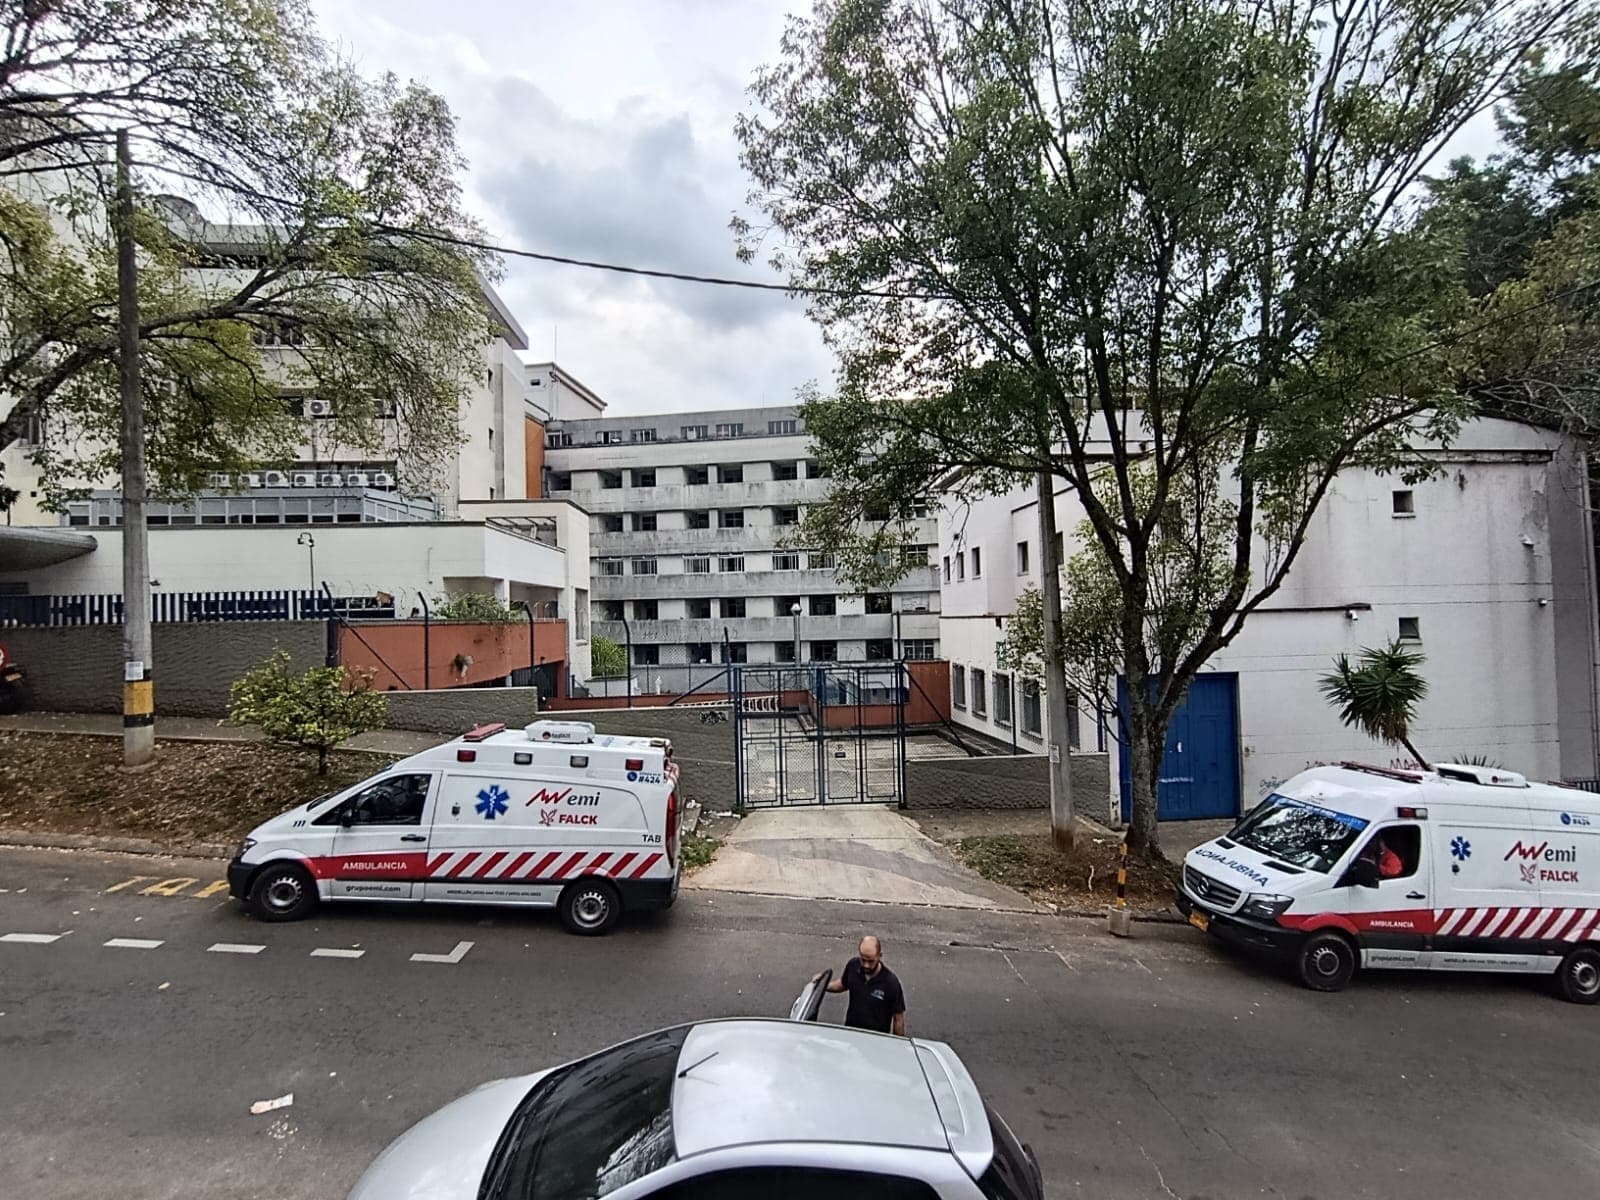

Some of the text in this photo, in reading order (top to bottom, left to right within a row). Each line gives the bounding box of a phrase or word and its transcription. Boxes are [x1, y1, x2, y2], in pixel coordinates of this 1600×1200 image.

[567, 792, 601, 806] emi
[559, 814, 598, 825] FALCK
[642, 834, 662, 843] TAB
[1544, 845, 1576, 862] emi
[342, 861, 407, 870] AMBULANCIA
[1540, 869, 1579, 883] FALCK
[1370, 920, 1414, 929] AMBULANCIA
